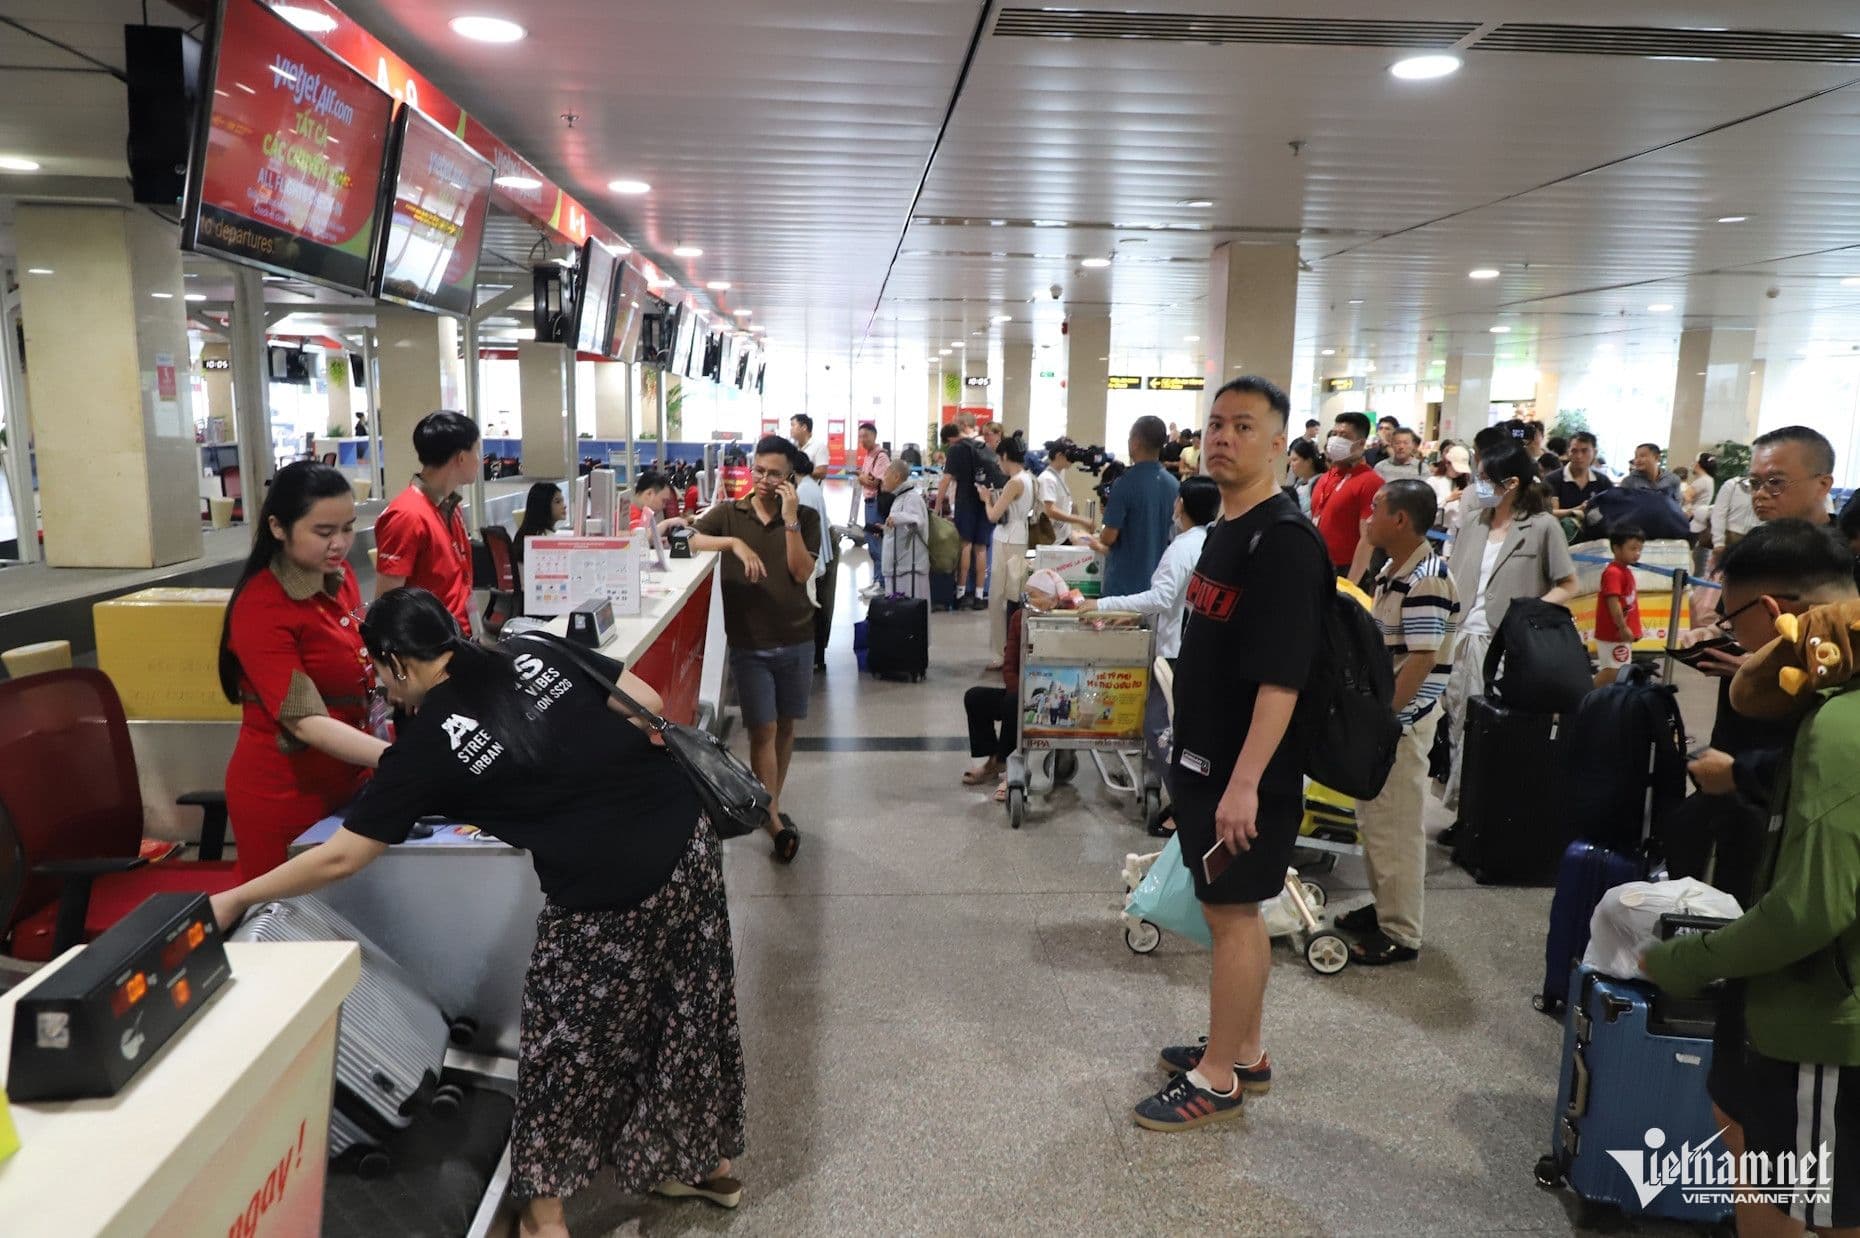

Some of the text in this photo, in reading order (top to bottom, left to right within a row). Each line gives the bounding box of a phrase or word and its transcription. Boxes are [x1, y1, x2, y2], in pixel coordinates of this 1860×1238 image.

[214, 219, 273, 254] departures
[206, 360, 228, 369] 10:05
[457, 667, 561, 763] STREE VIBES
[469, 741, 505, 776] URBAN
